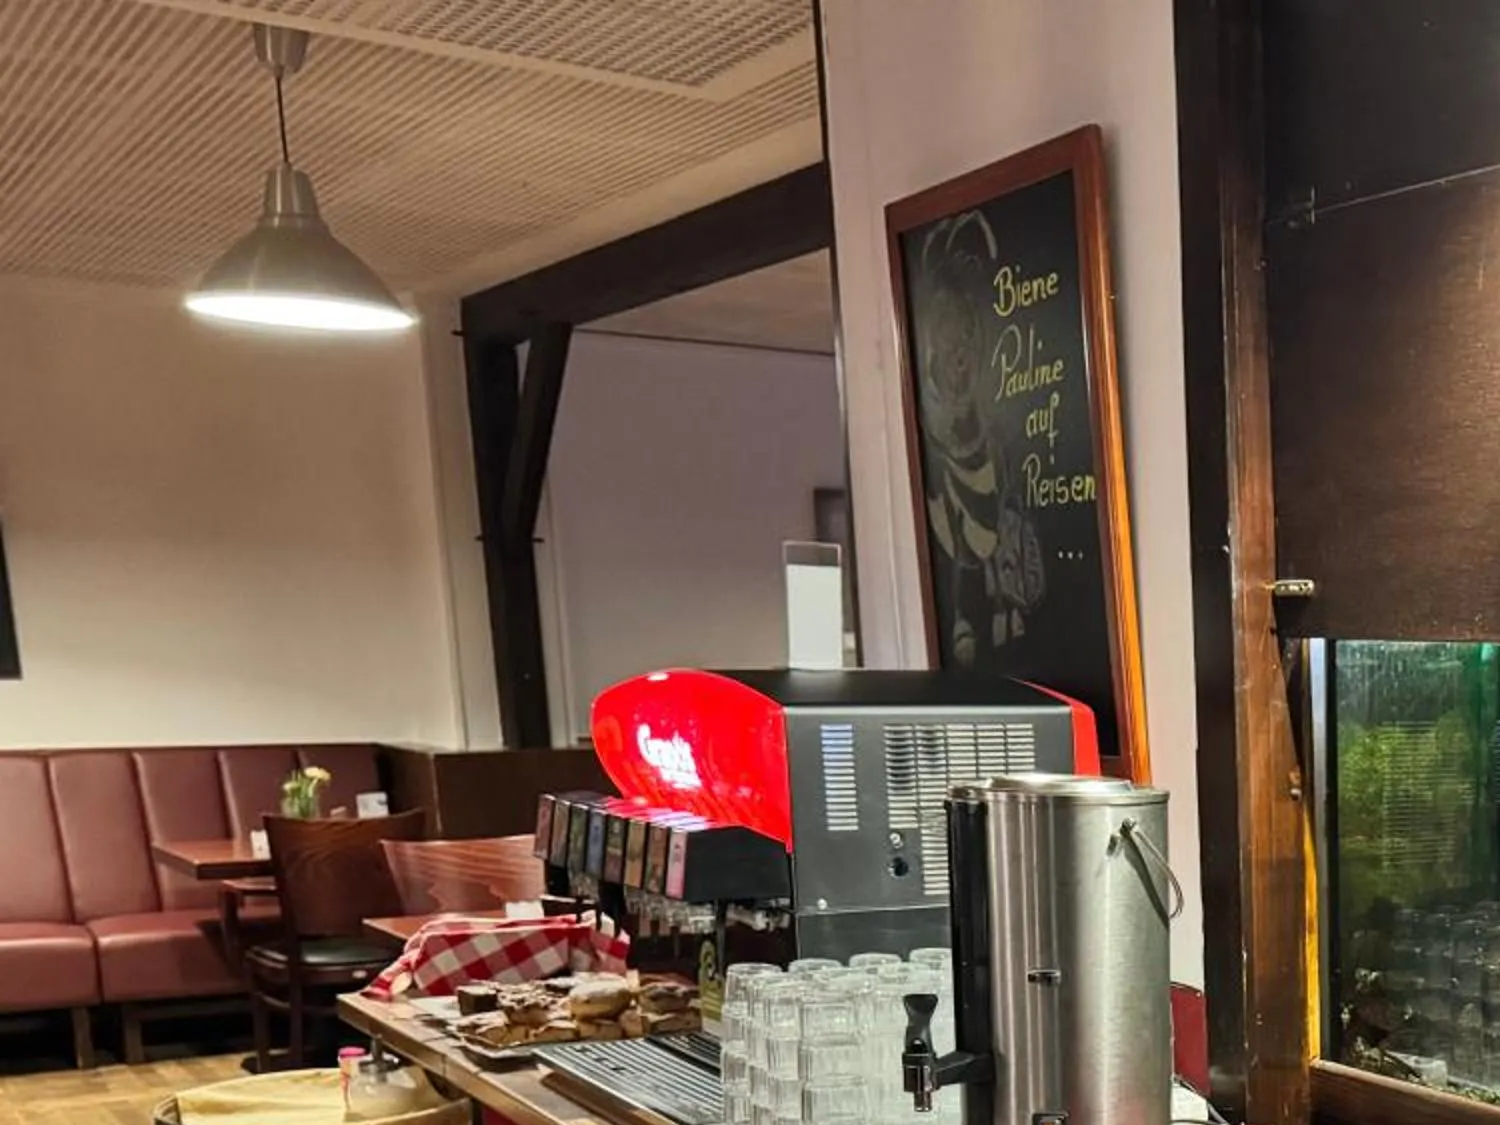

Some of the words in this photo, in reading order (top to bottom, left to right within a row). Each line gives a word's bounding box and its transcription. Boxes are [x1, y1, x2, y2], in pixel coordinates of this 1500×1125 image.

[993, 265, 1059, 317] Biene
[991, 322, 1064, 402] Pauline
[1025, 391, 1060, 448] auf
[1021, 453, 1097, 508] Reisen
